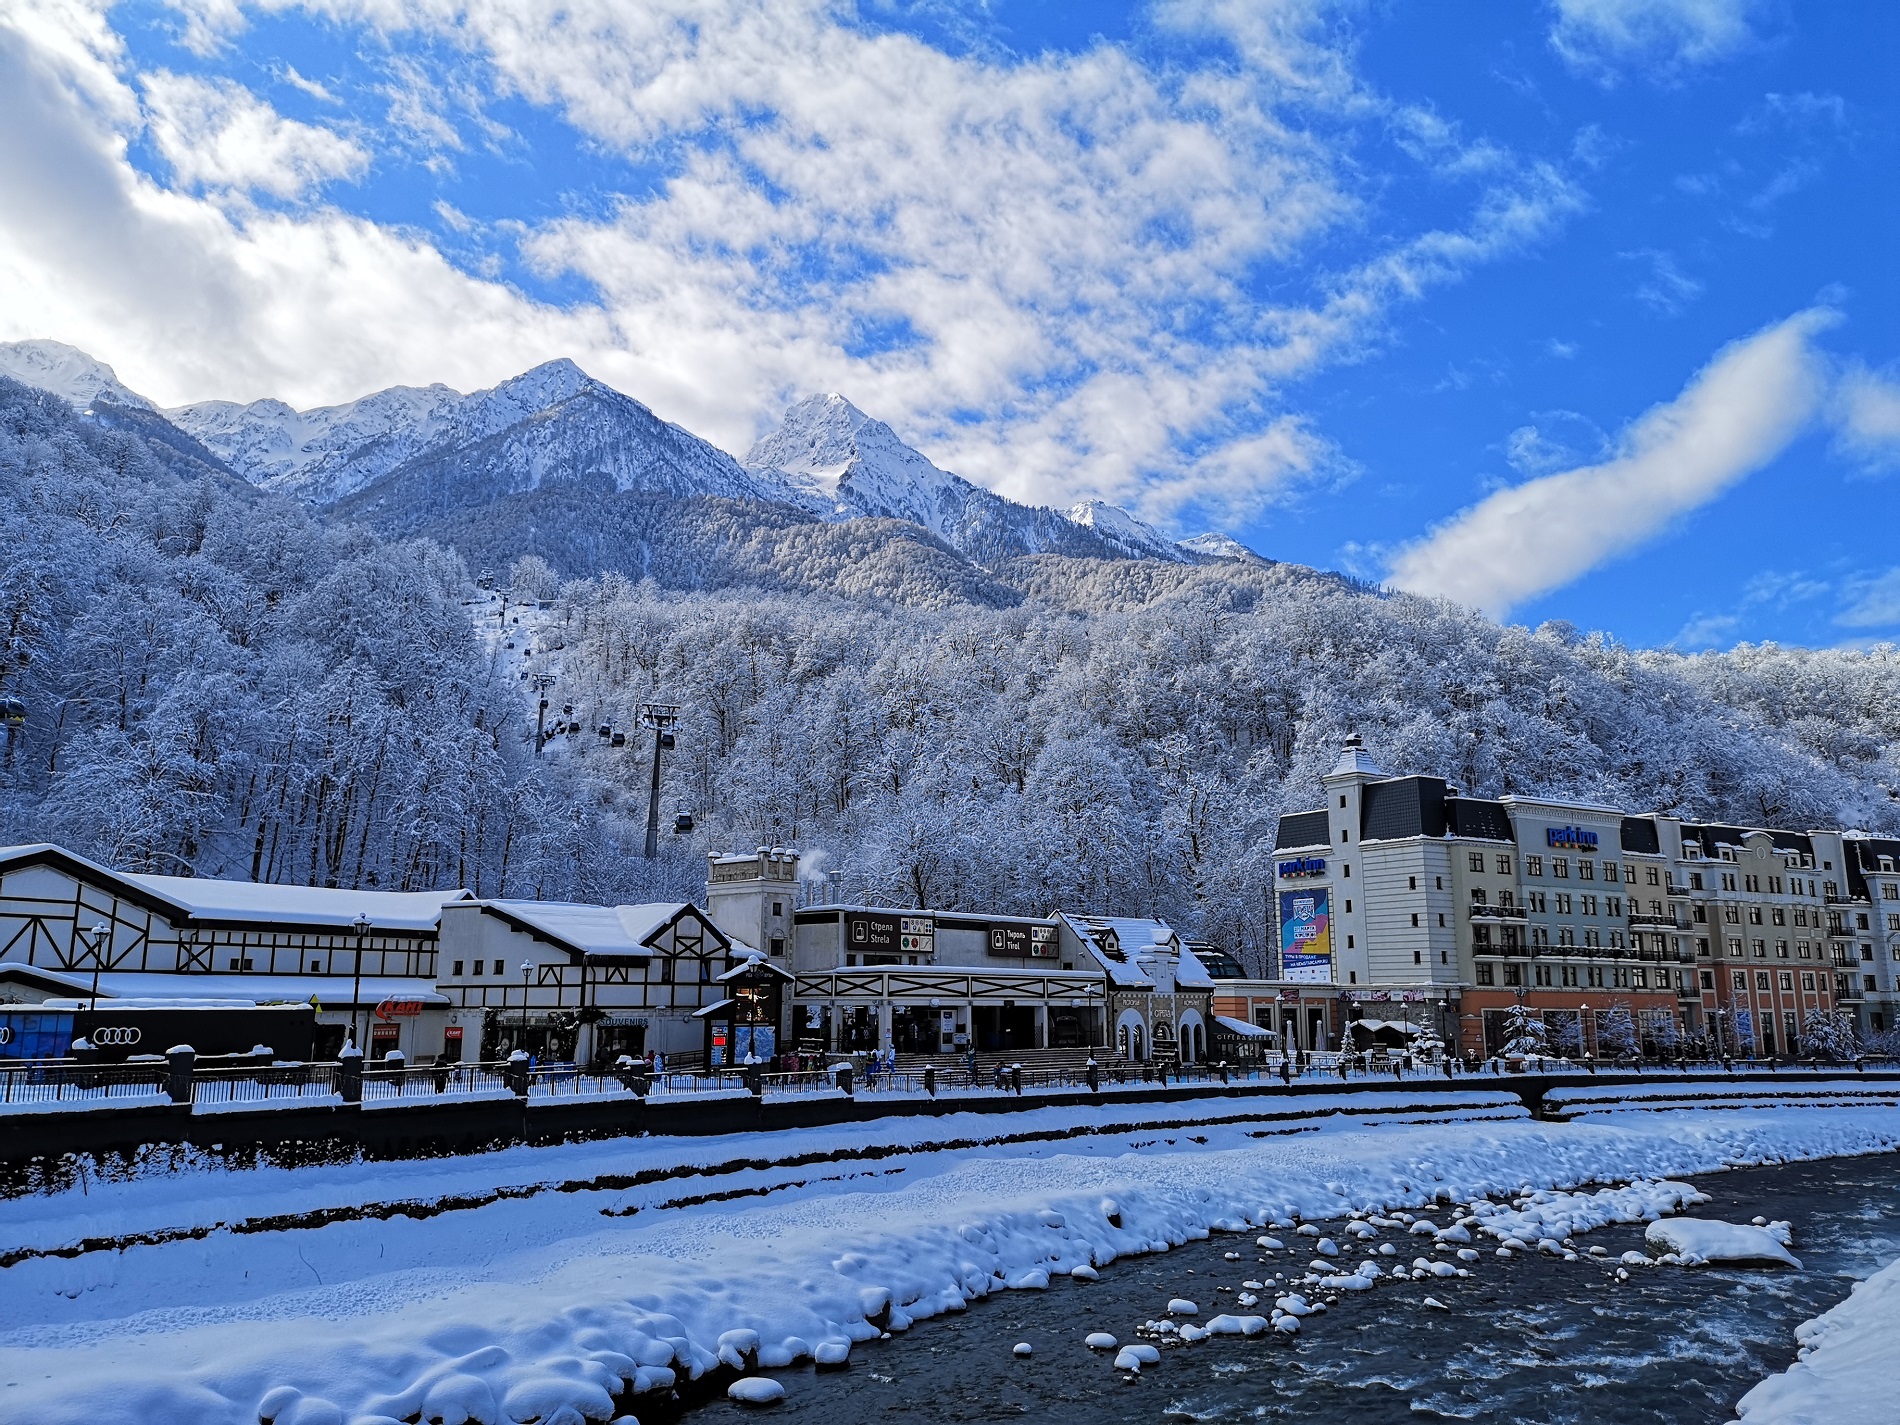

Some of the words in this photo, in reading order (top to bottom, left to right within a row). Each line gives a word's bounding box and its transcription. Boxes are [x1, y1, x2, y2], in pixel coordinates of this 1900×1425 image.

[1547, 826, 1576, 847] park
[1576, 827, 1599, 845] inn
[1279, 857, 1305, 878] park
[1306, 855, 1326, 870] inn
[871, 921, 893, 932] Стрела
[870, 933, 890, 944] Strela
[1006, 929, 1026, 940] Тироль
[1006, 941, 1021, 950] Tirol
[384, 1001, 424, 1012] КАНТ
[600, 1017, 649, 1027] SOUVENIRS
